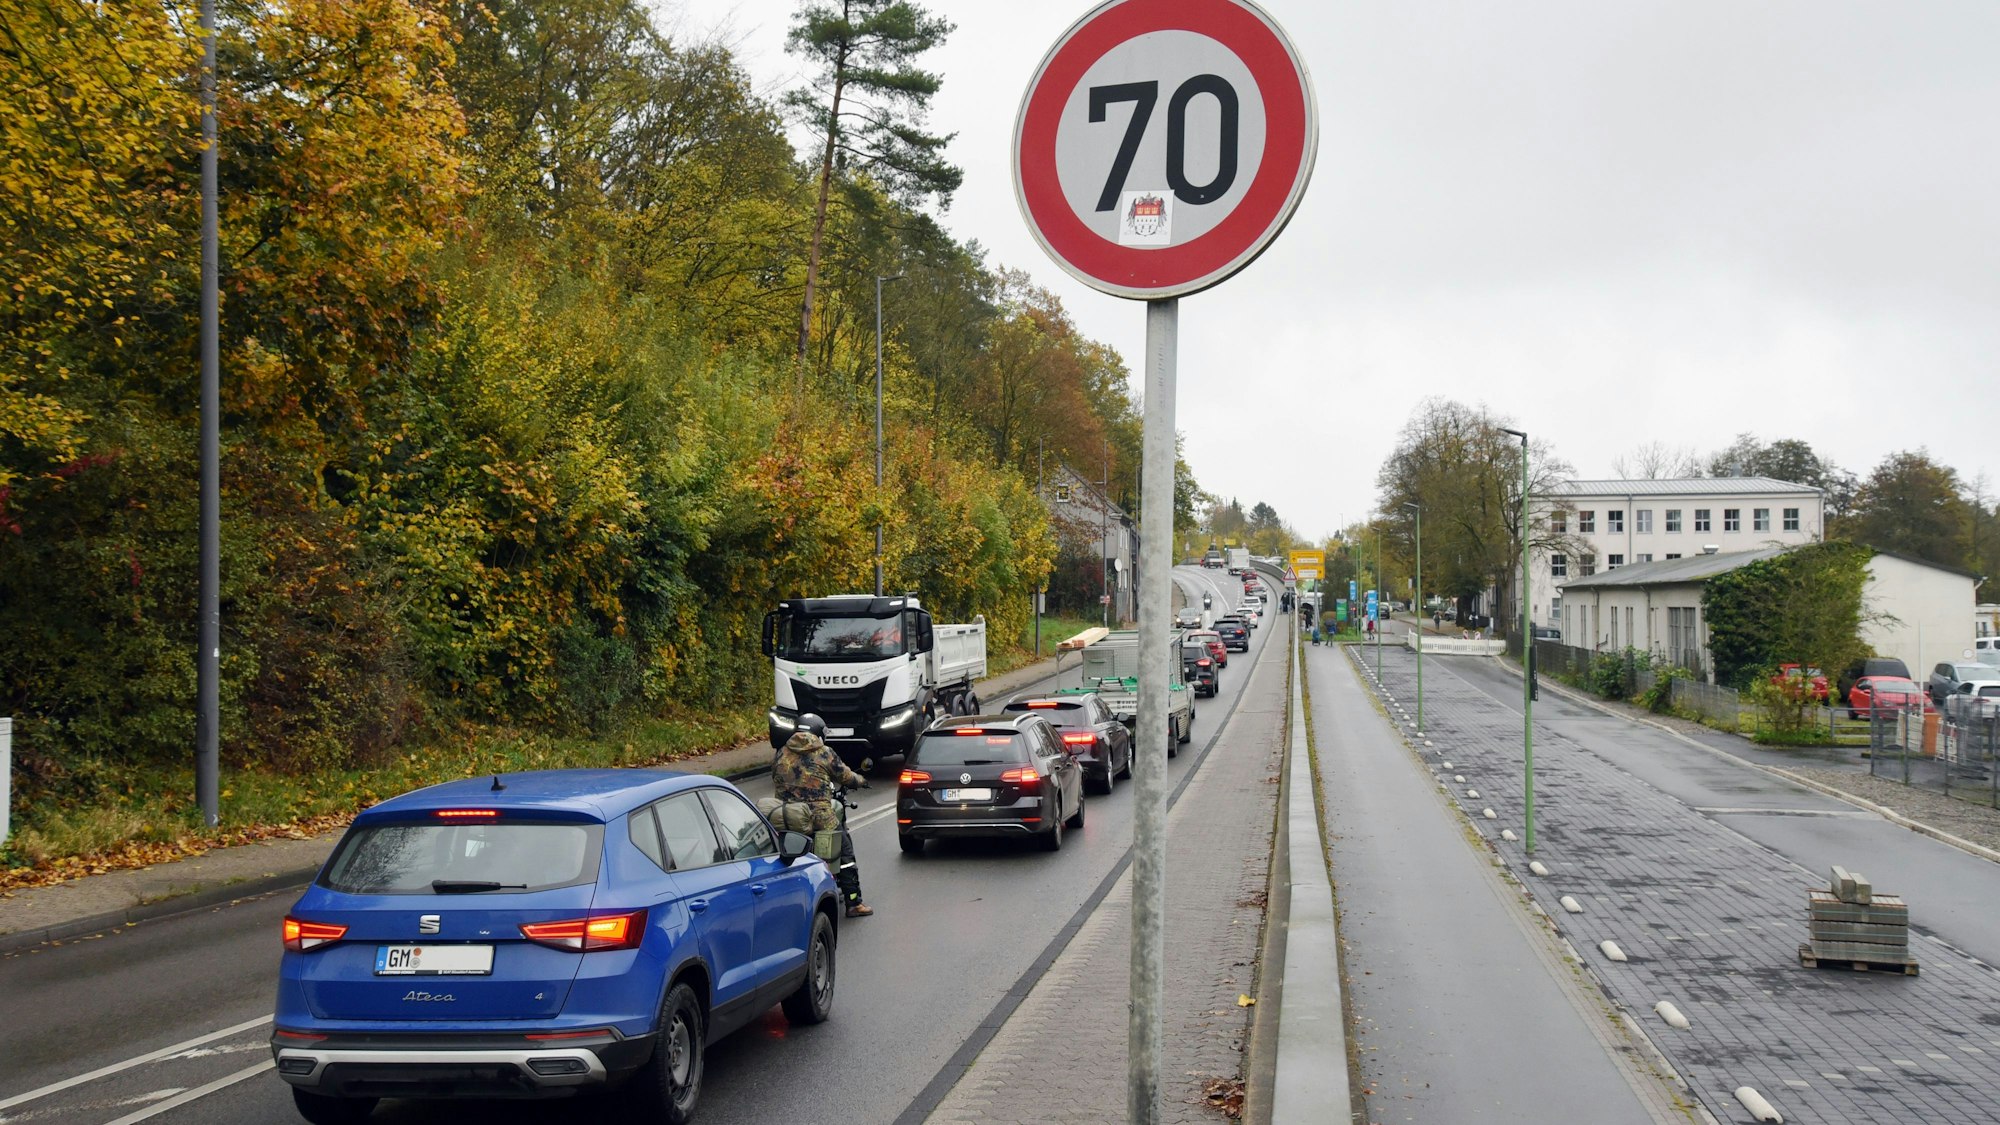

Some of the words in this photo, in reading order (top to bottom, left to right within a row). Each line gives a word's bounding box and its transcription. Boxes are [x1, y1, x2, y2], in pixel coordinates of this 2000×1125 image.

[1089, 74, 1239, 212] 70
[817, 675, 859, 685] IVECO
[388, 949, 411, 968] GM
[402, 990, 456, 1002] Ateca
[535, 992, 543, 1001] 4
